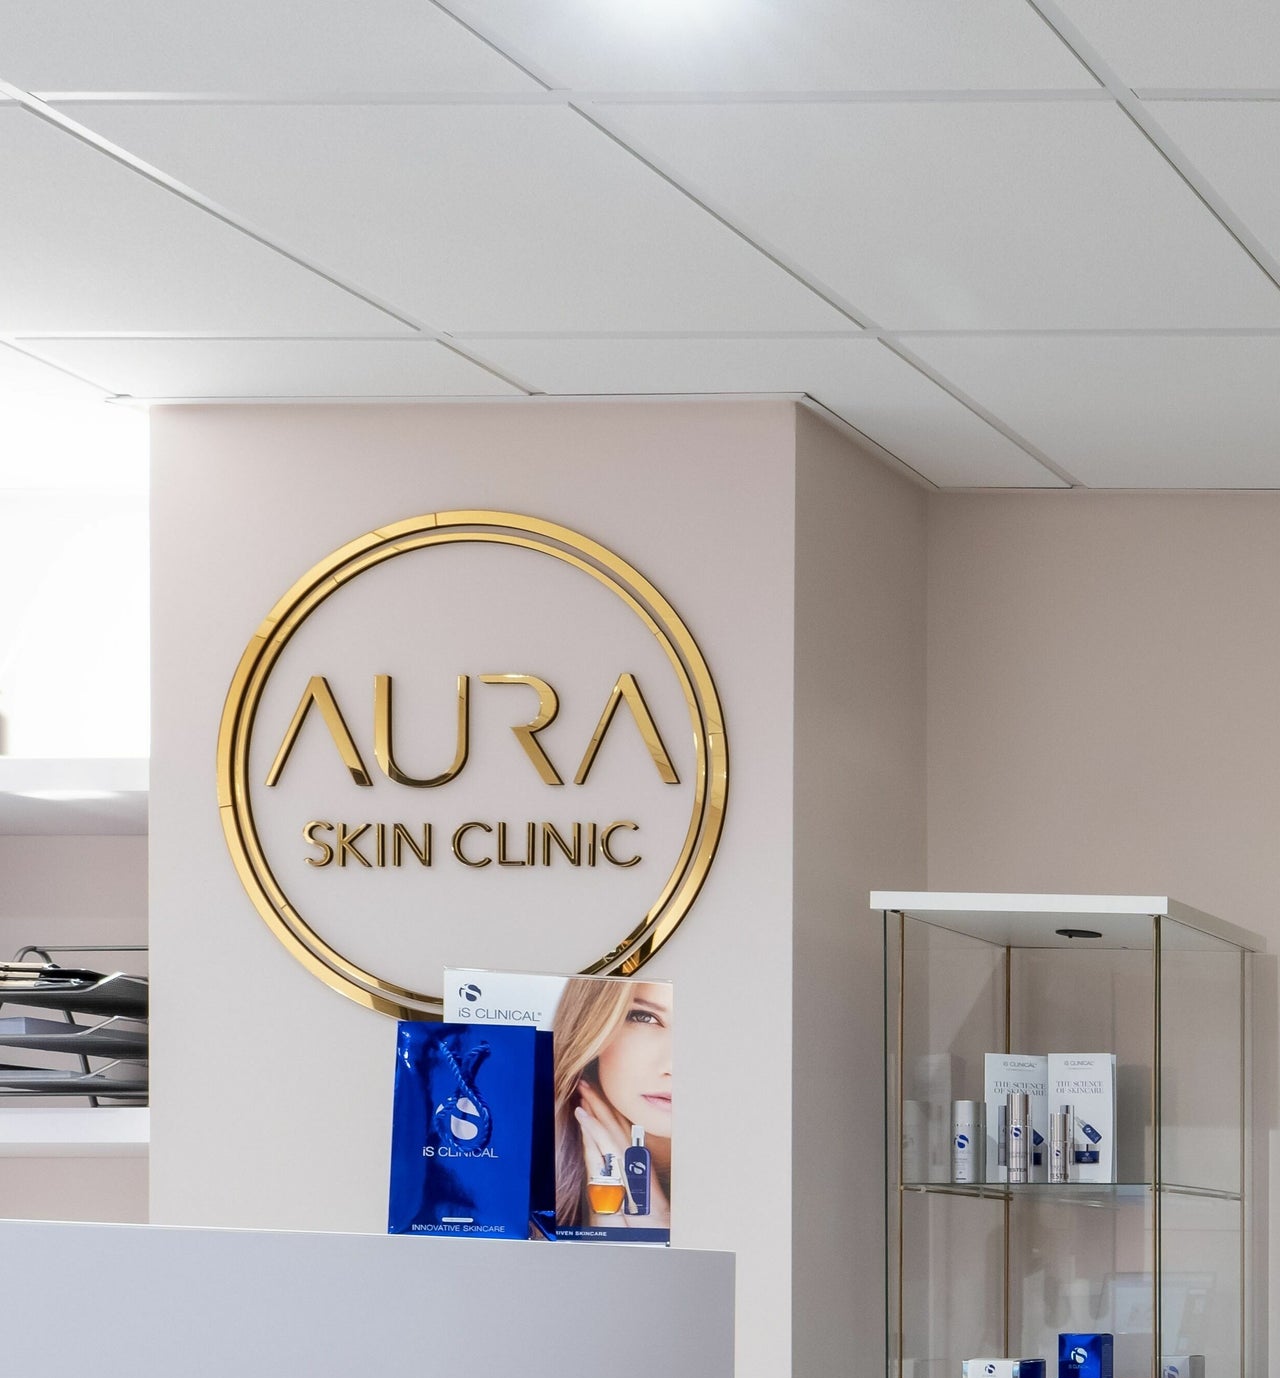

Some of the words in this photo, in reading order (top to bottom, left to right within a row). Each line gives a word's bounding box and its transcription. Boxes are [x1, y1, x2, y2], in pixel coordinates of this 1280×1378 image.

[264, 673, 681, 788] AURA
[302, 821, 436, 868] SKIN
[451, 821, 643, 868] CLINIC
[458, 1007, 471, 1018] iS
[1013, 1082, 1046, 1090] SCIENCE
[422, 1146, 435, 1157] iS
[411, 1223, 461, 1233] INNOVATIVE
[463, 1225, 505, 1233] SKINCARE
